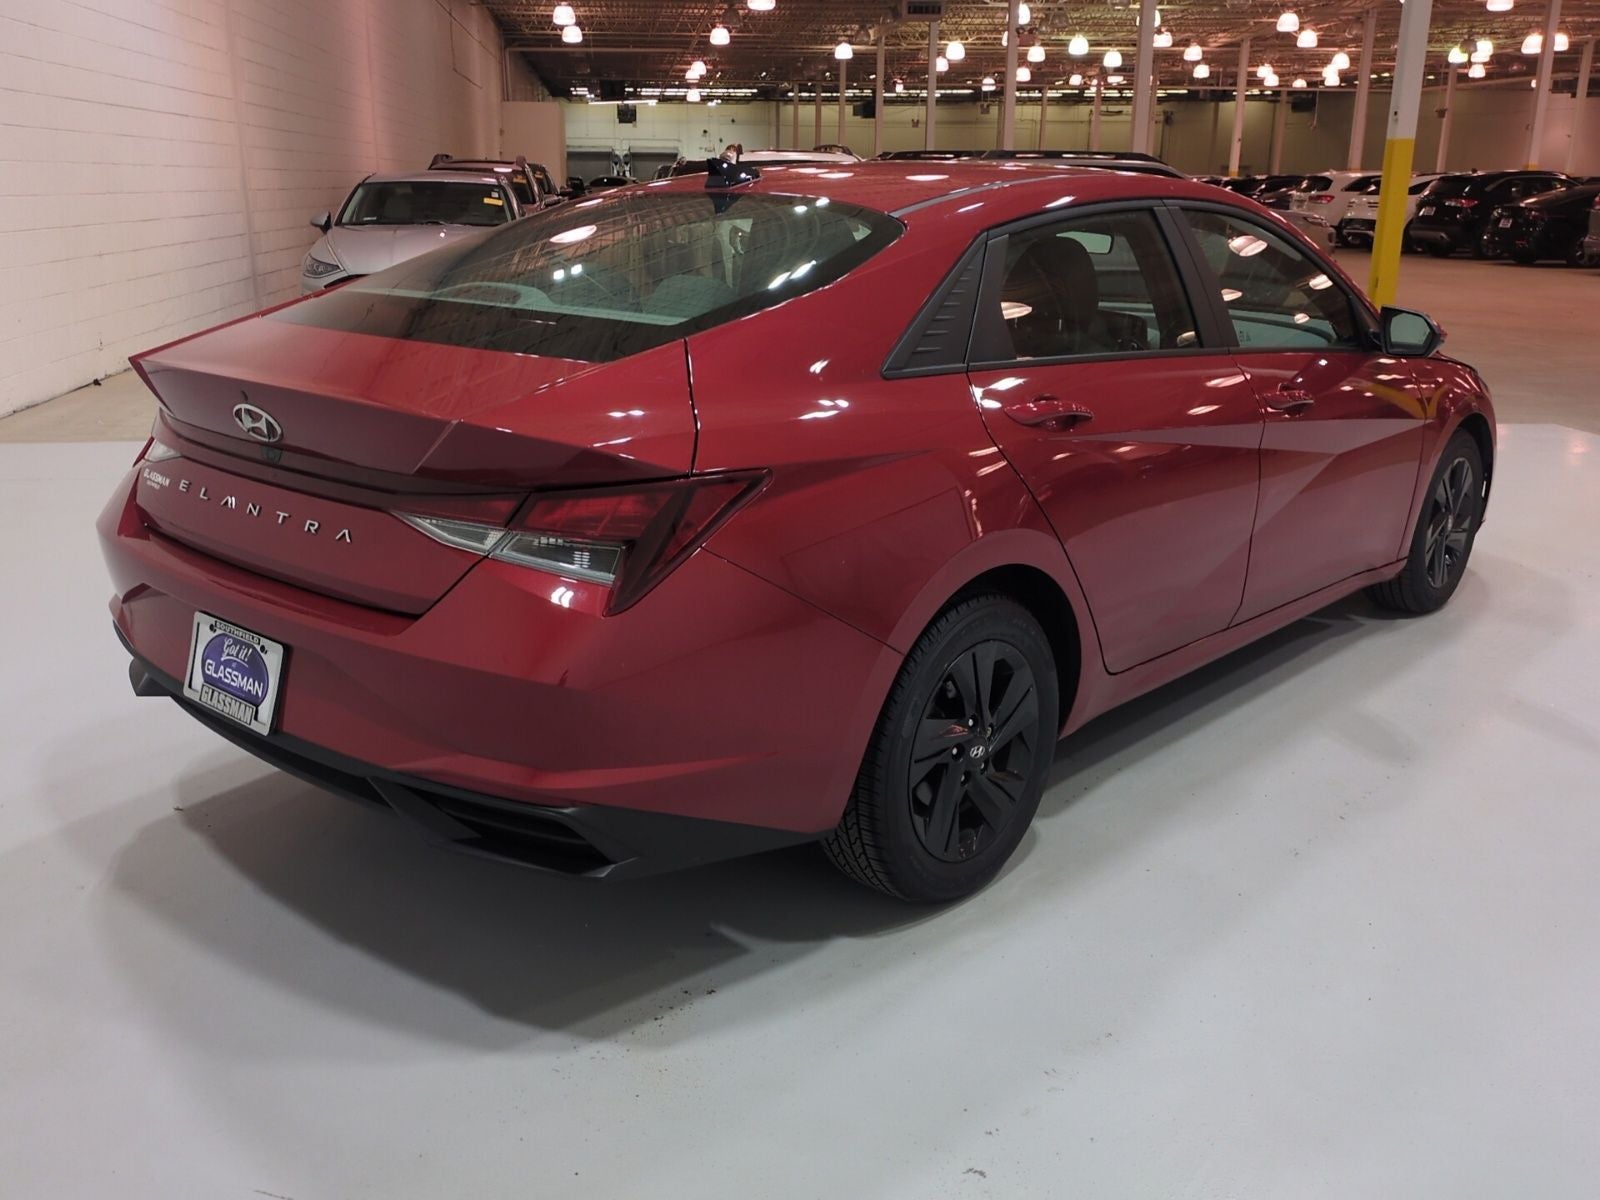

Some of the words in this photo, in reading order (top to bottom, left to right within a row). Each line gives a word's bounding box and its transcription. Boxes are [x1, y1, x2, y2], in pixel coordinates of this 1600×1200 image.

[179, 479, 352, 543] ELANTRA
[216, 622, 259, 643] SOUTHFIELD
[223, 638, 239, 660] Got
[204, 659, 263, 698] GLASSMAN
[201, 685, 253, 724] GLASSMAN
